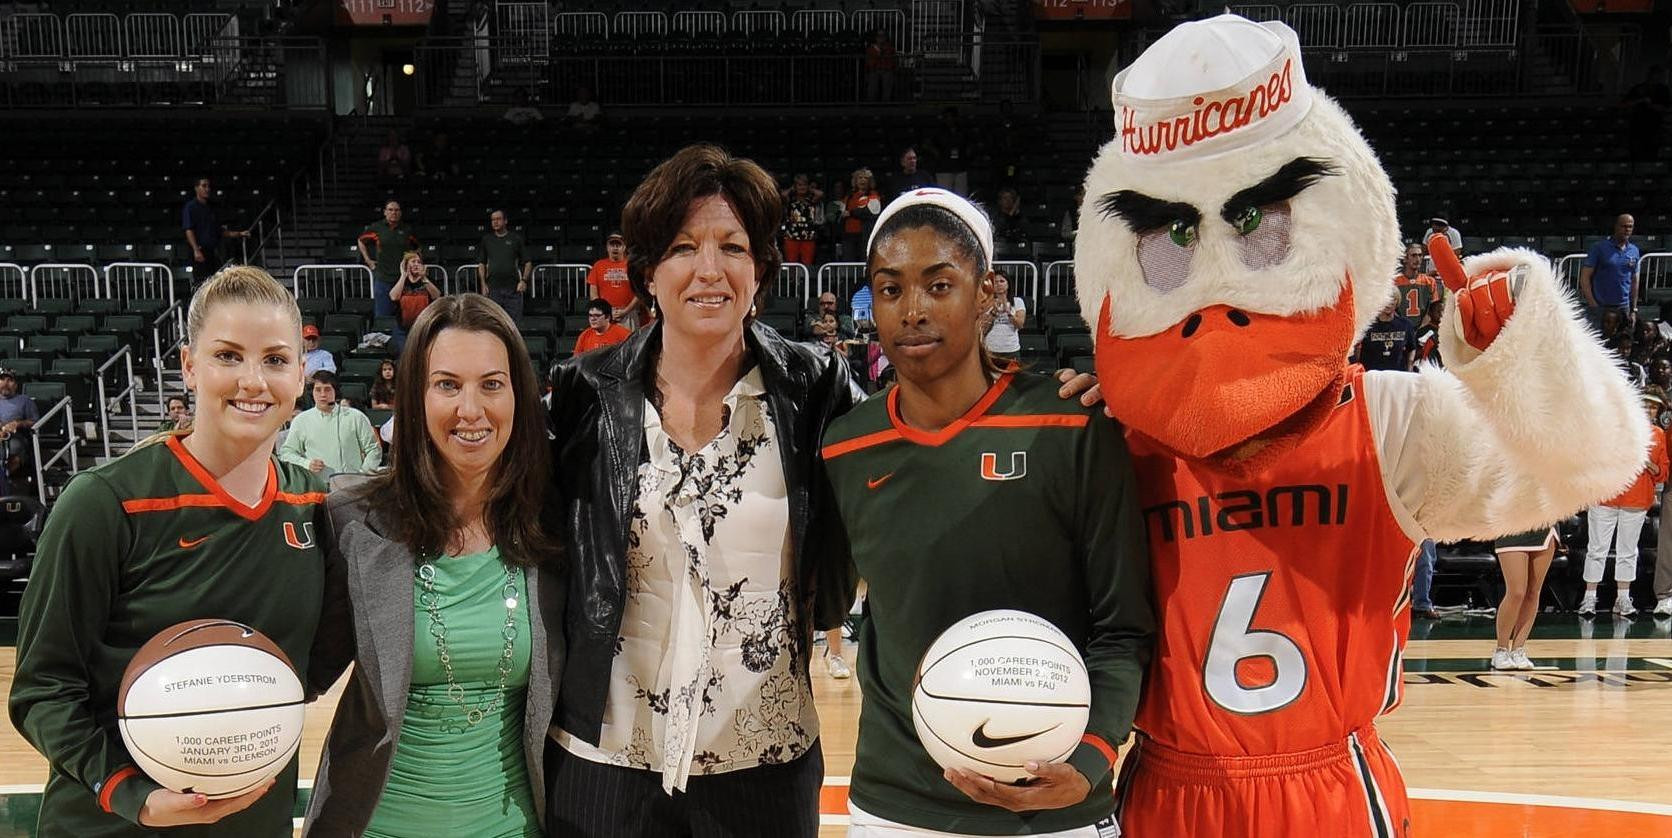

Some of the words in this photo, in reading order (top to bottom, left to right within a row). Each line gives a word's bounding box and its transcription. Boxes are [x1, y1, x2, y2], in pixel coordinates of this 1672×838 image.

[400, 0, 424, 13] 112
[1121, 58, 1292, 155] Hurricanes
[1406, 288, 1420, 317] 1
[980, 451, 1027, 481] U
[1201, 569, 1308, 715] 6
[971, 657, 995, 668] 1,000
[998, 656, 1038, 666] CAREER
[1041, 659, 1071, 674] POINTS
[164, 676, 213, 693] STEFANIE
[216, 674, 277, 685] YDERSTROM
[975, 666, 1032, 677] NOVEMBER
[1051, 671, 1069, 684] 2012
[991, 678, 1022, 686] MIAMI
[1038, 680, 1055, 690] FAU
[175, 736, 202, 746] 1,000
[204, 734, 248, 746] CAREER
[250, 723, 282, 741] POINTS
[180, 746, 230, 756] JANUARY
[259, 736, 279, 749] 2013
[183, 757, 215, 765] MIAMI
[231, 746, 277, 763] CLEMSON
